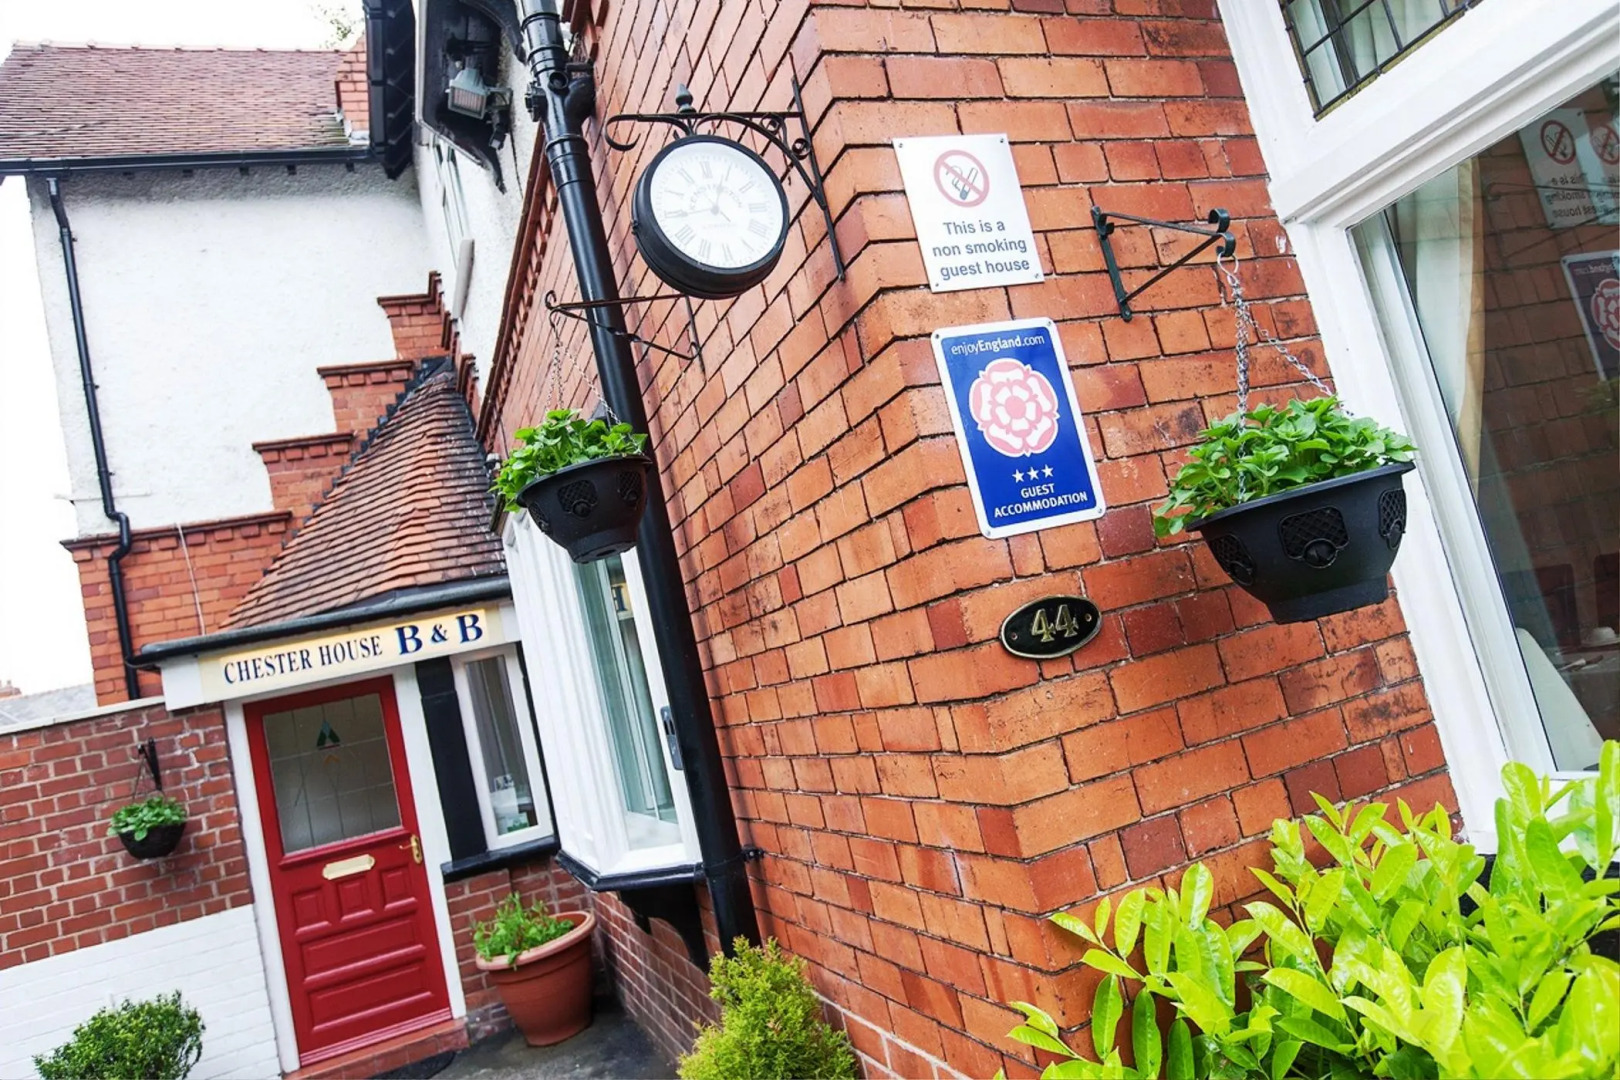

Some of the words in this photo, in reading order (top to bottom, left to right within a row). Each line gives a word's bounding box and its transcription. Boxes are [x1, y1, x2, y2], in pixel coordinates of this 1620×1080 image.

[943, 221, 976, 235] This
[978, 219, 993, 233] is
[996, 220, 1005, 232] a
[932, 245, 961, 257] non
[965, 238, 1027, 254] smoking
[940, 262, 982, 281] guest
[985, 260, 1030, 273] house
[951, 335, 1045, 356] enjoyEngland.com
[1021, 483, 1055, 498] GUEST
[994, 491, 1088, 518] ACCOMMODATION
[1031, 604, 1079, 642] 44
[224, 649, 313, 684] CHESTER
[318, 635, 384, 666] HOUSE
[394, 624, 423, 655] B
[431, 623, 449, 643] &
[456, 613, 483, 643] B
